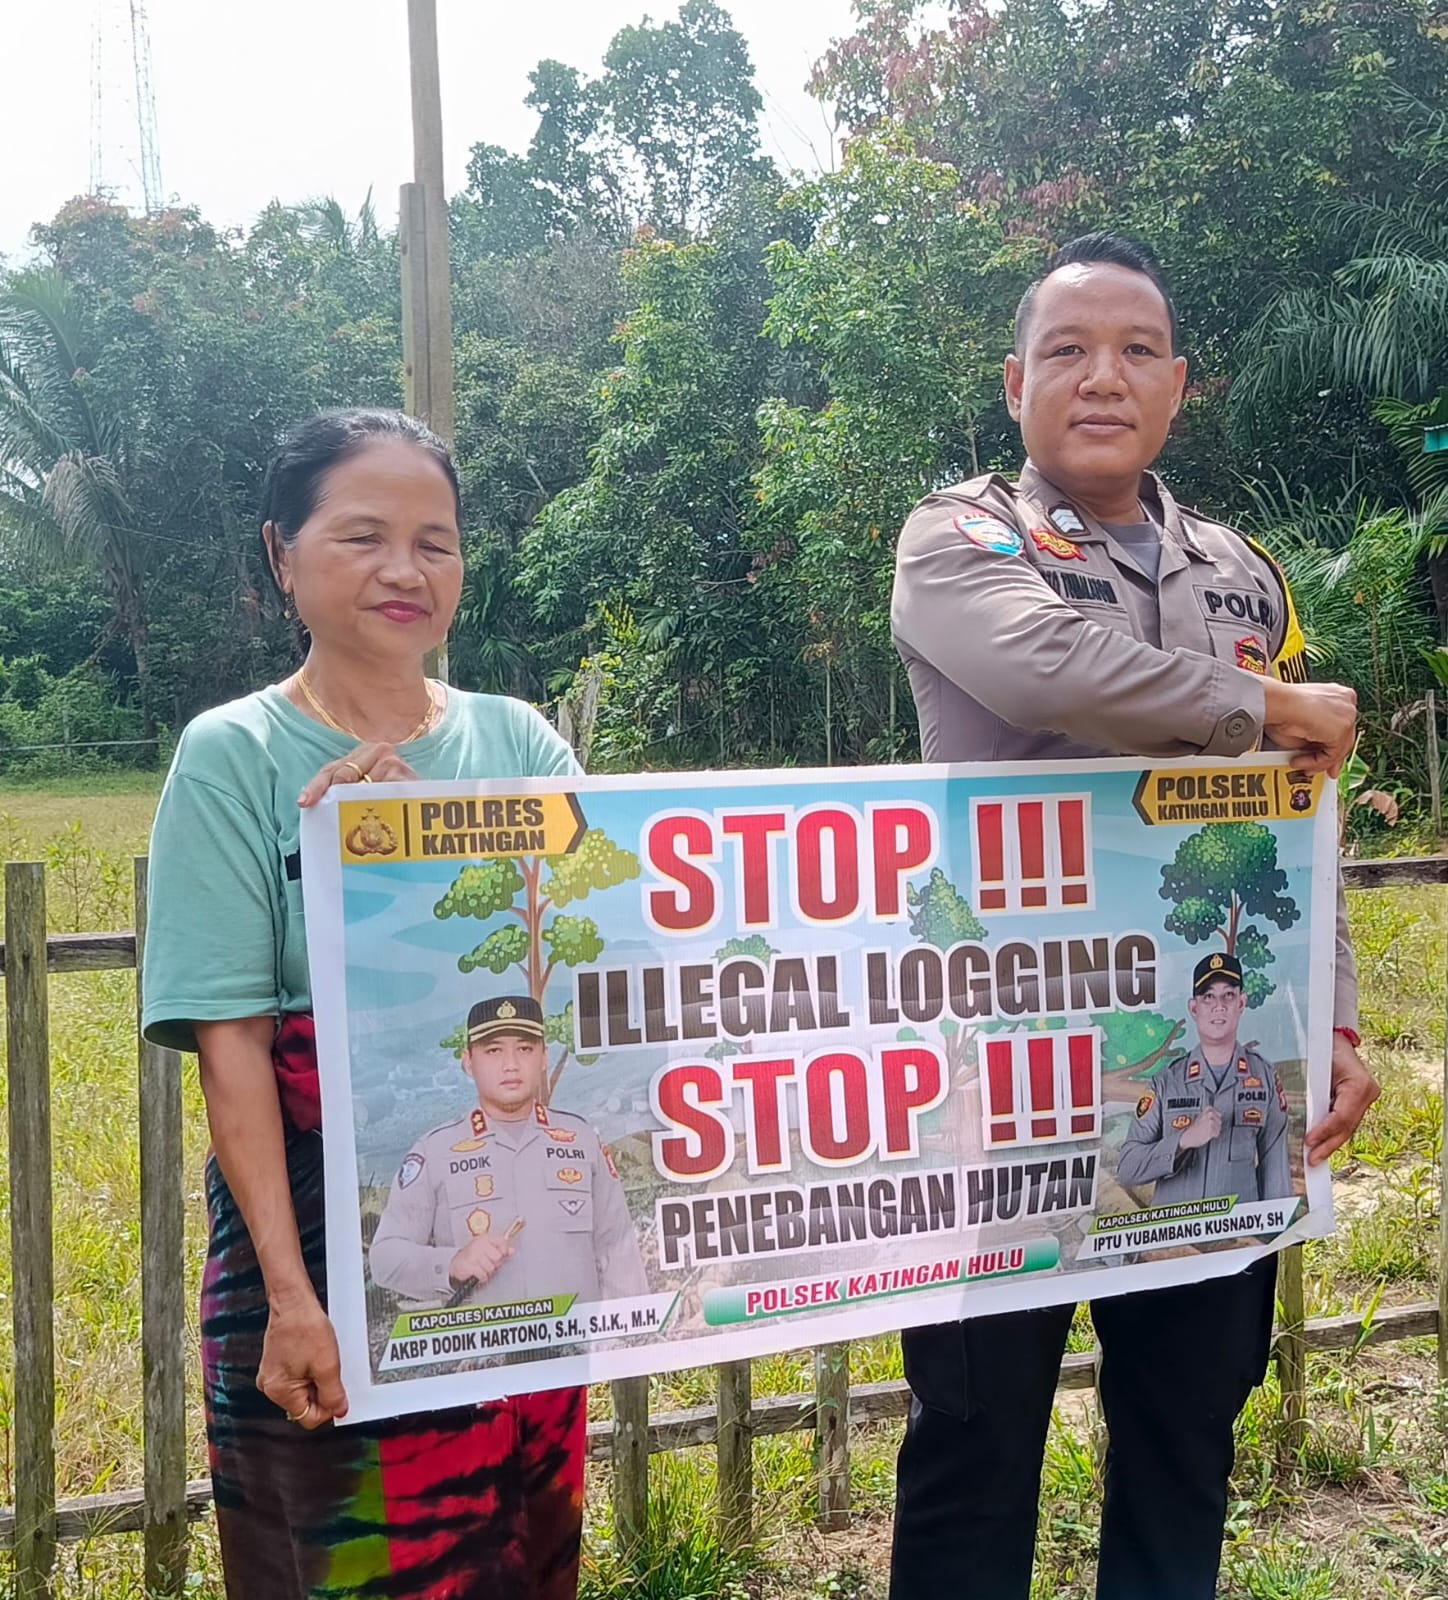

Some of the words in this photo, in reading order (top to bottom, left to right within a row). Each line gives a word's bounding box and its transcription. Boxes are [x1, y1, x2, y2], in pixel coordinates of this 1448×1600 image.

[1157, 773, 1267, 801] POLSEK
[420, 798, 545, 831] POLRES
[1158, 802, 1229, 821] KATINGAN
[1232, 800, 1269, 817] HULU
[421, 830, 545, 855] KATINGAN
[648, 807, 932, 930] STOP
[977, 799, 1087, 910] !!!
[577, 951, 850, 1048] ILLEGAL
[867, 934, 1156, 1025] LOGGING
[657, 1047, 941, 1176] STOP
[985, 1034, 1095, 1143] !!!
[450, 1156, 492, 1174] DODIK
[546, 1147, 585, 1160] POLRI
[660, 1173, 956, 1264] PENEBANGAN
[966, 1155, 1096, 1226] HUTAN
[1098, 1209, 1149, 1229] KAPOLSEK
[1151, 1203, 1200, 1220] KATINGAN
[1202, 1199, 1230, 1212] HULU
[1093, 1233, 1122, 1252] IPTU
[1126, 1223, 1201, 1247] YUBAMBANG
[1205, 1214, 1264, 1235] KUSNADY,
[1267, 1211, 1284, 1227] SH
[746, 1282, 838, 1314] POLSEK
[848, 1260, 960, 1297] KATINGAN
[967, 1247, 1024, 1273] HULU
[410, 1310, 482, 1331] KAPOLRES
[485, 1300, 553, 1320] KATINGAN
[390, 1339, 428, 1362] AKBP
[432, 1331, 476, 1356] DODIK
[480, 1321, 552, 1350] HARTONO,
[555, 1319, 586, 1338] S.H.,
[590, 1313, 628, 1333] S.I.K.,
[632, 1308, 660, 1327] M.H.
